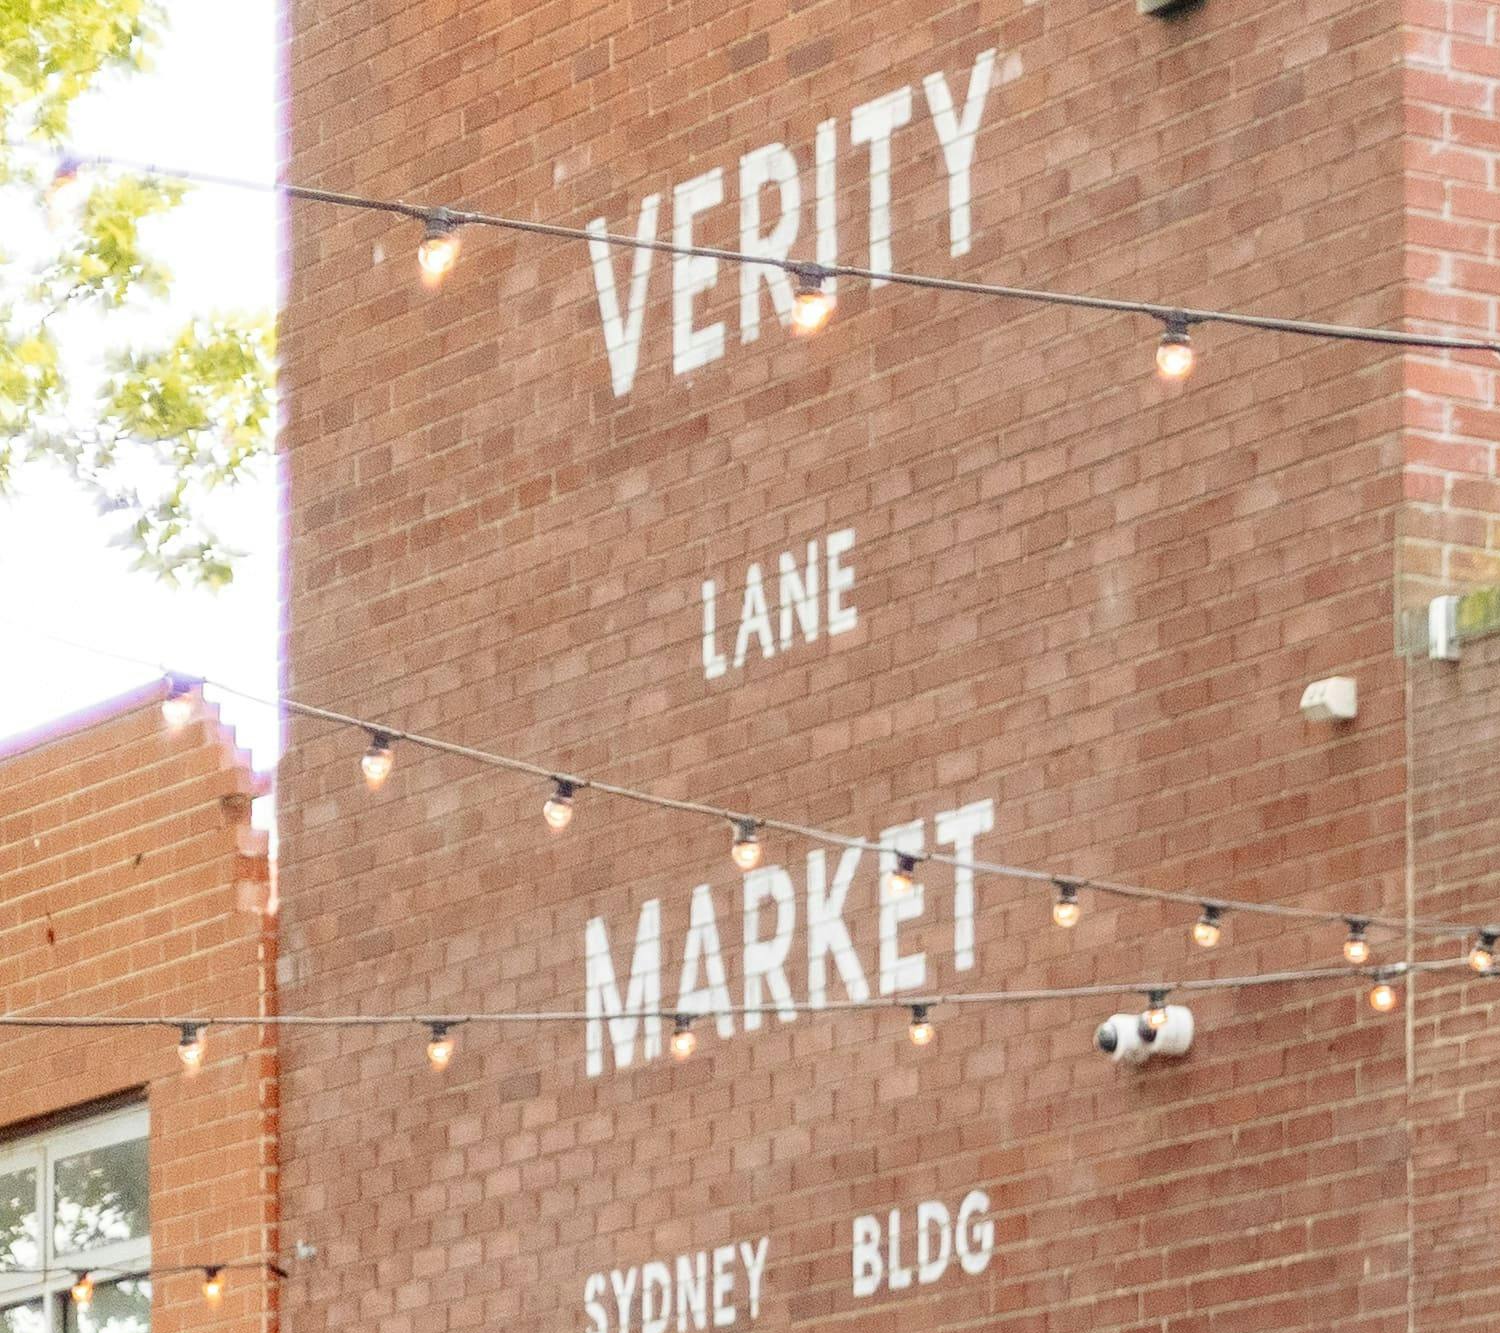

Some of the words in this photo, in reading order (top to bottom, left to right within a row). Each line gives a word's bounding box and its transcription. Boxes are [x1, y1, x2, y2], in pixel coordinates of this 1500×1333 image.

[585, 48, 997, 398] VERITY
[701, 527, 859, 681] LANE
[584, 798, 995, 1078] MARKET
[852, 1190, 995, 1298] BLDG
